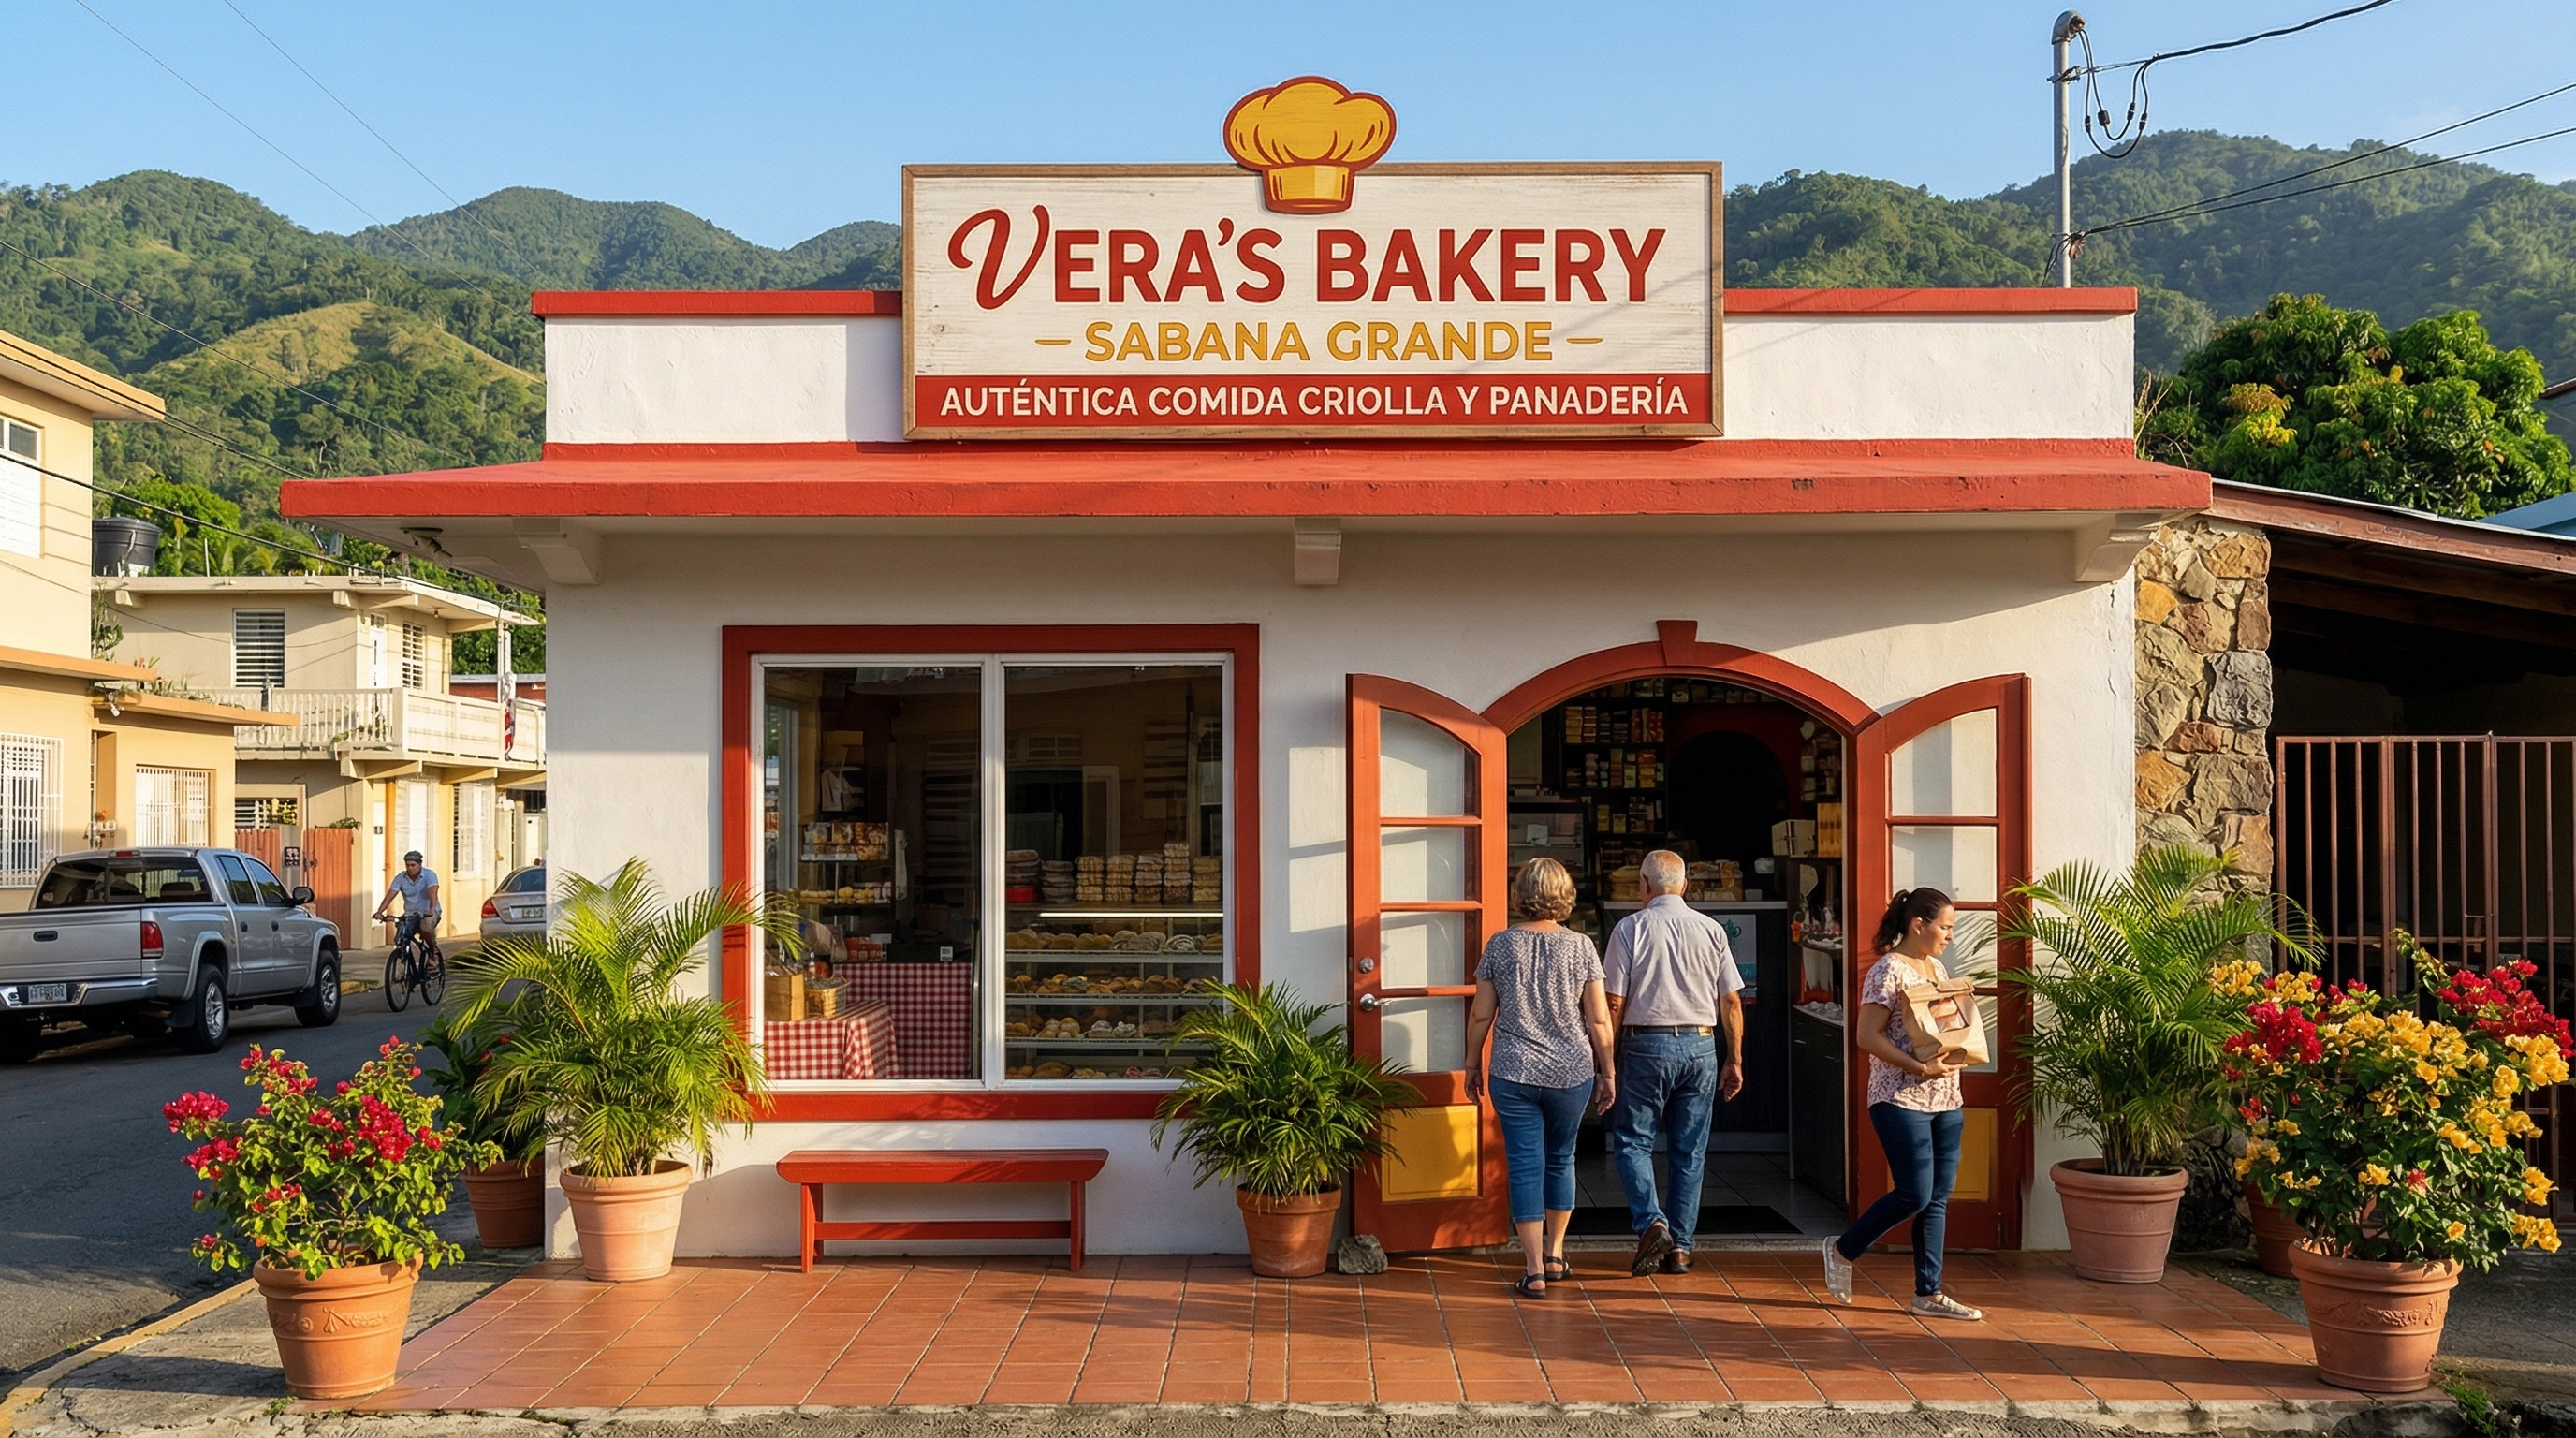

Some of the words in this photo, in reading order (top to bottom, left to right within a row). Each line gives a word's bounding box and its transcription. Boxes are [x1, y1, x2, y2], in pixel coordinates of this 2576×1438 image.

[947, 203, 1287, 311] VERA'S
[1316, 227, 1667, 304] BAKERY
[1083, 321, 1310, 362] SABANA
[1326, 321, 1554, 362] GRANDE
[940, 378, 1139, 417] AUTÉNTICA
[1149, 386, 1288, 417] COMIDA
[1298, 385, 1447, 416] CRIOLLA
[1456, 386, 1480, 416] Y
[1490, 376, 1689, 416] PANADERÍA
